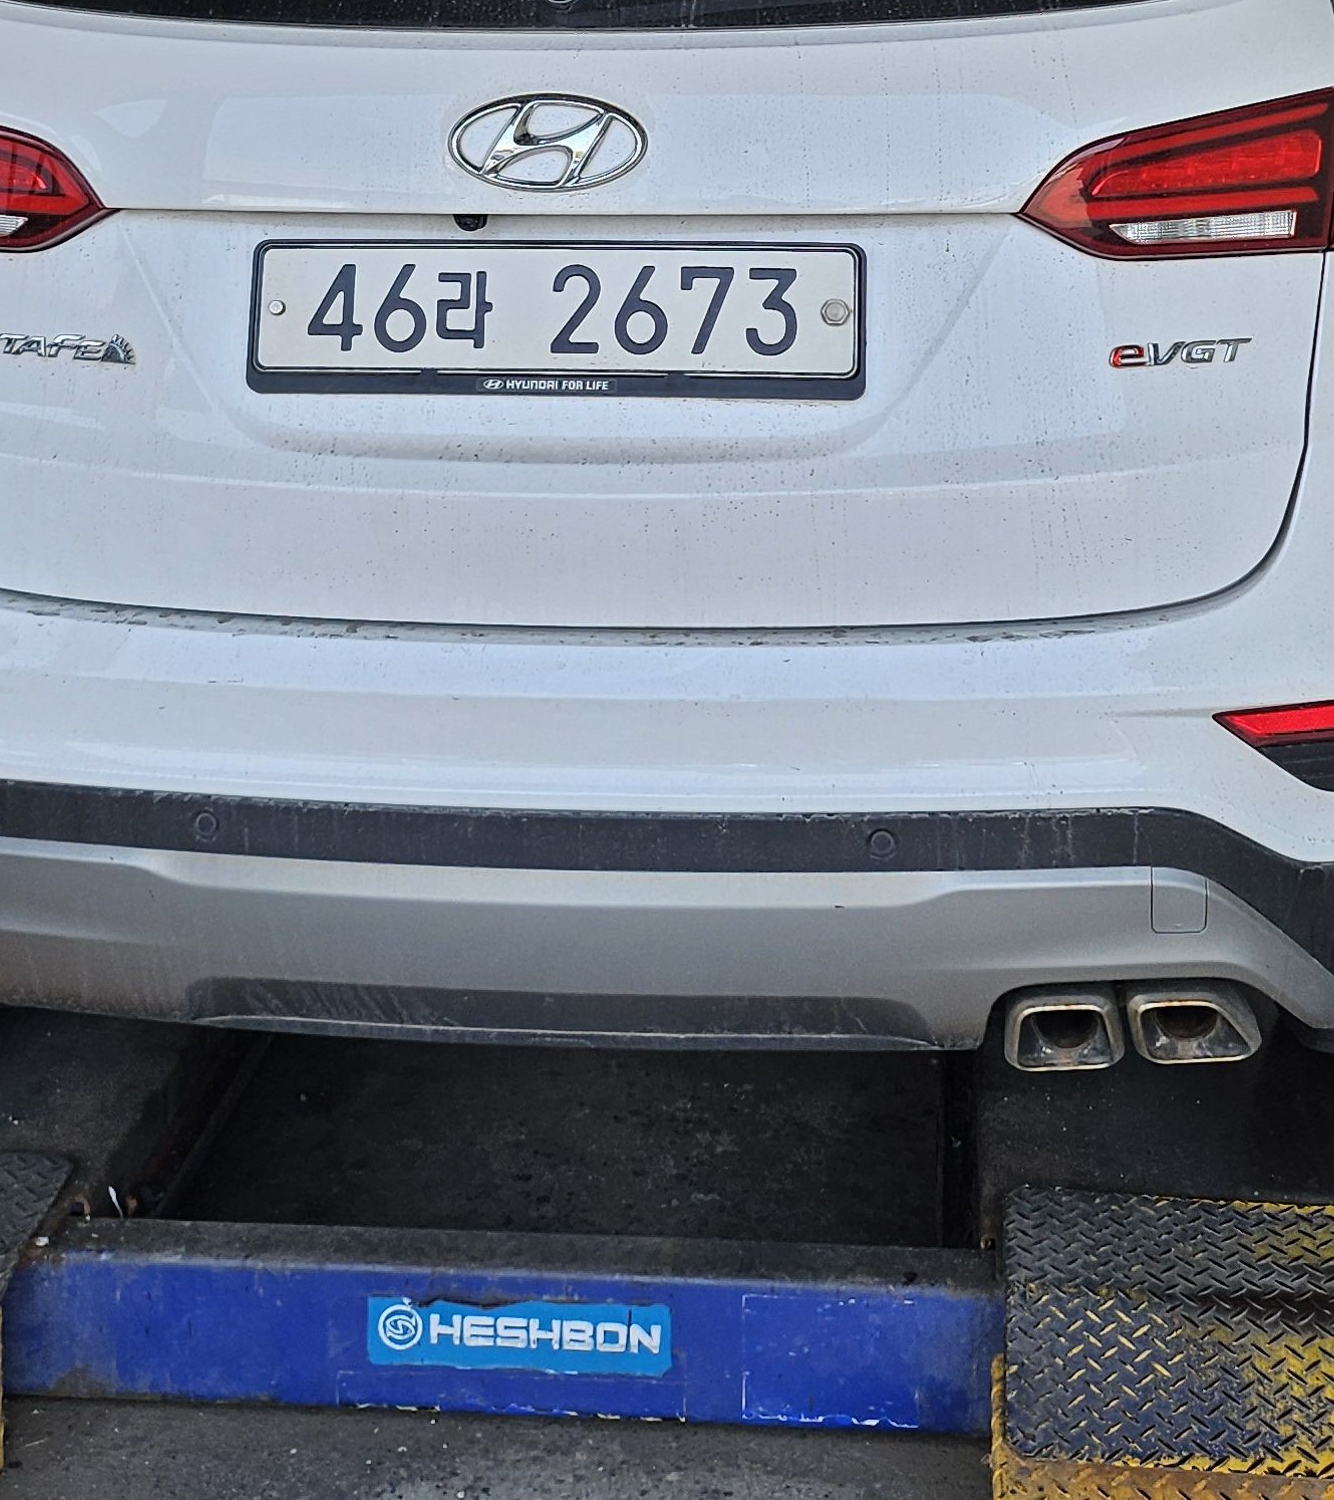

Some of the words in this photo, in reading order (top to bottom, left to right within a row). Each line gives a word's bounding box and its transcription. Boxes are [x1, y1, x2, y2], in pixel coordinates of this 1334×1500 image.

[307, 263, 493, 353] 46라
[549, 264, 799, 356] 2673
[1108, 337, 1253, 369] eVGT
[506, 379, 559, 391] HYUNDAI
[561, 380, 584, 391] FOR
[585, 380, 609, 391] LIFE
[428, 1313, 663, 1355] HESHBON
